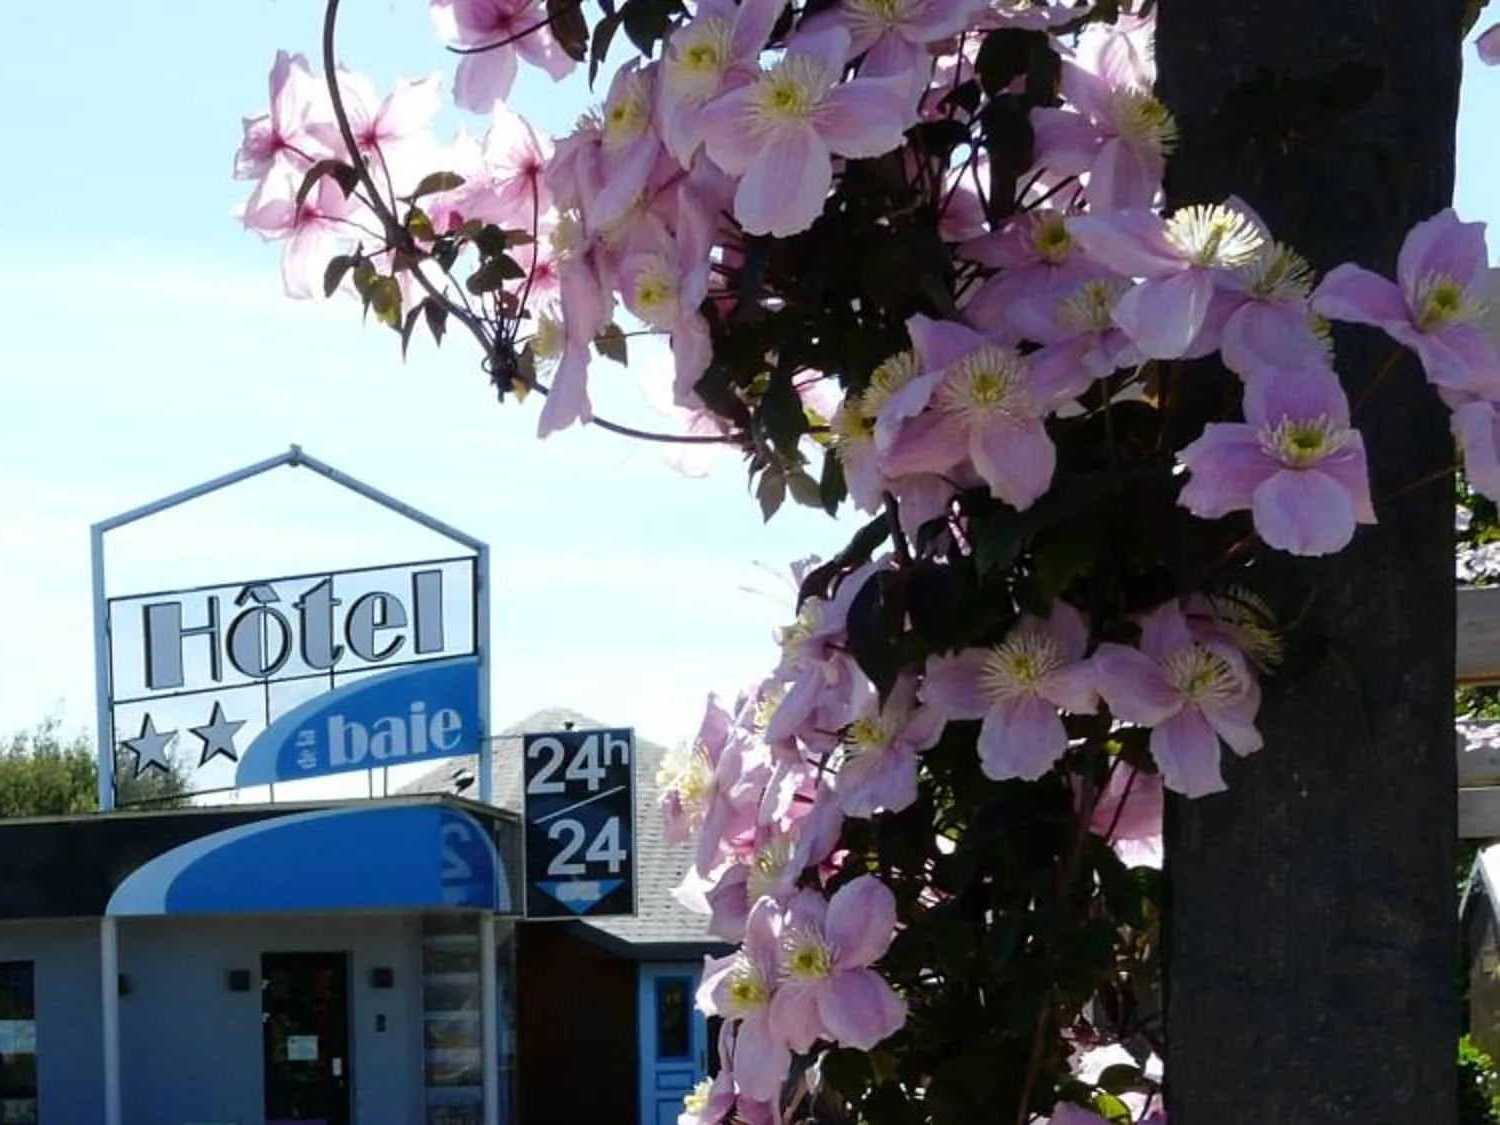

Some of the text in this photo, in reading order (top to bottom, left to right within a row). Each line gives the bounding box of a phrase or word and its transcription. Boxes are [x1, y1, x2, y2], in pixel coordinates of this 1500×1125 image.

[143, 569, 445, 690] Hôtel
[328, 701, 463, 767] baie
[527, 733, 629, 794] 24h
[548, 816, 627, 875] 24
